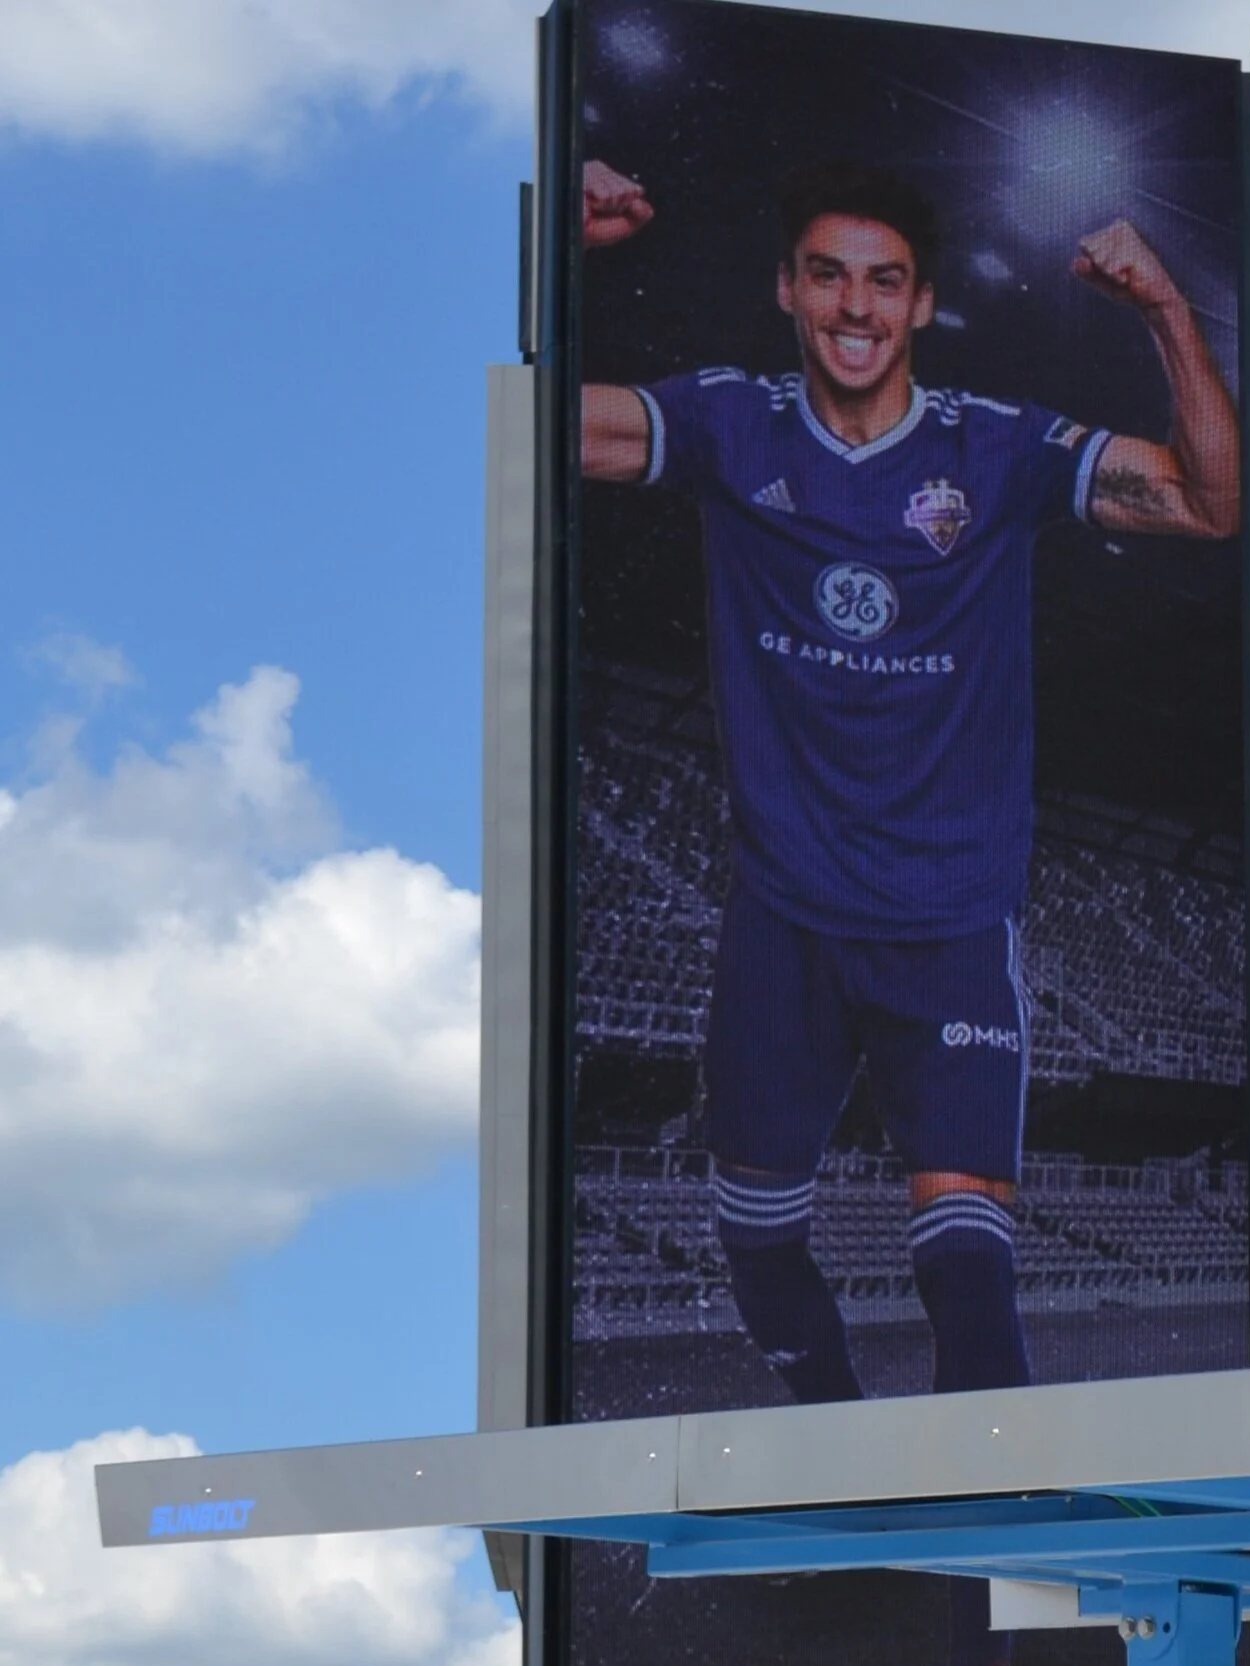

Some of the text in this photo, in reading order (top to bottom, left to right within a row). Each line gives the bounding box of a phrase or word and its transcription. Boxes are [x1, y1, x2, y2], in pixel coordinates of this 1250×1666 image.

[759, 631, 955, 674] GE APPLIANCES
[148, 1499, 256, 1537] SUNBOLT
